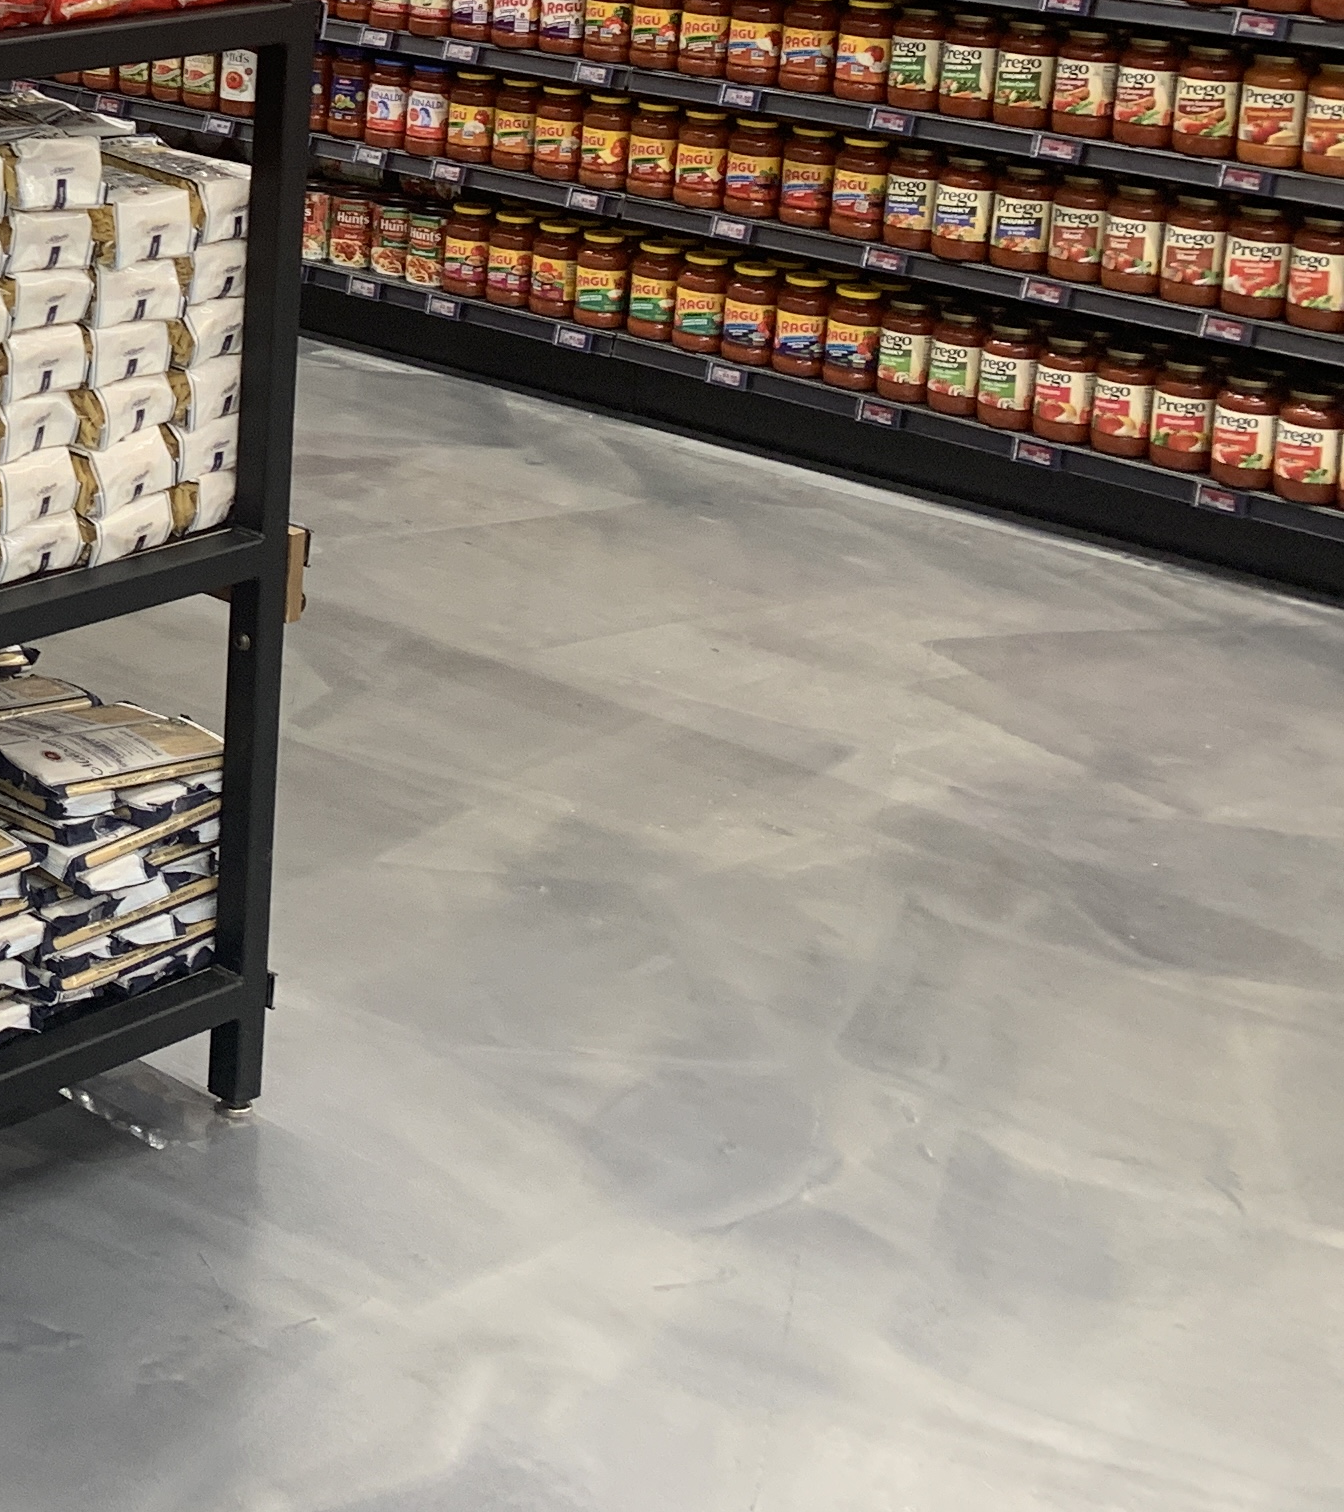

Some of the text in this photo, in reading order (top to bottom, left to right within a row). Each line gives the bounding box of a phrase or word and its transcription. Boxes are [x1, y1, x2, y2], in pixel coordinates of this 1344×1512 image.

[547, 0, 583, 14] RAGÚ
[684, 19, 721, 34] RAGÚ
[785, 33, 821, 48] RAGÚ
[1179, 81, 1226, 99] Prego
[1245, 89, 1295, 108] Prego
[998, 197, 1043, 217] Prego
[381, 218, 408, 233] Hunt
[1054, 208, 1099, 227] Prego
[410, 226, 441, 243] Hunt's
[1167, 227, 1215, 248] Prego
[1231, 241, 1282, 262] Prego
[1158, 396, 1206, 417] Prego
